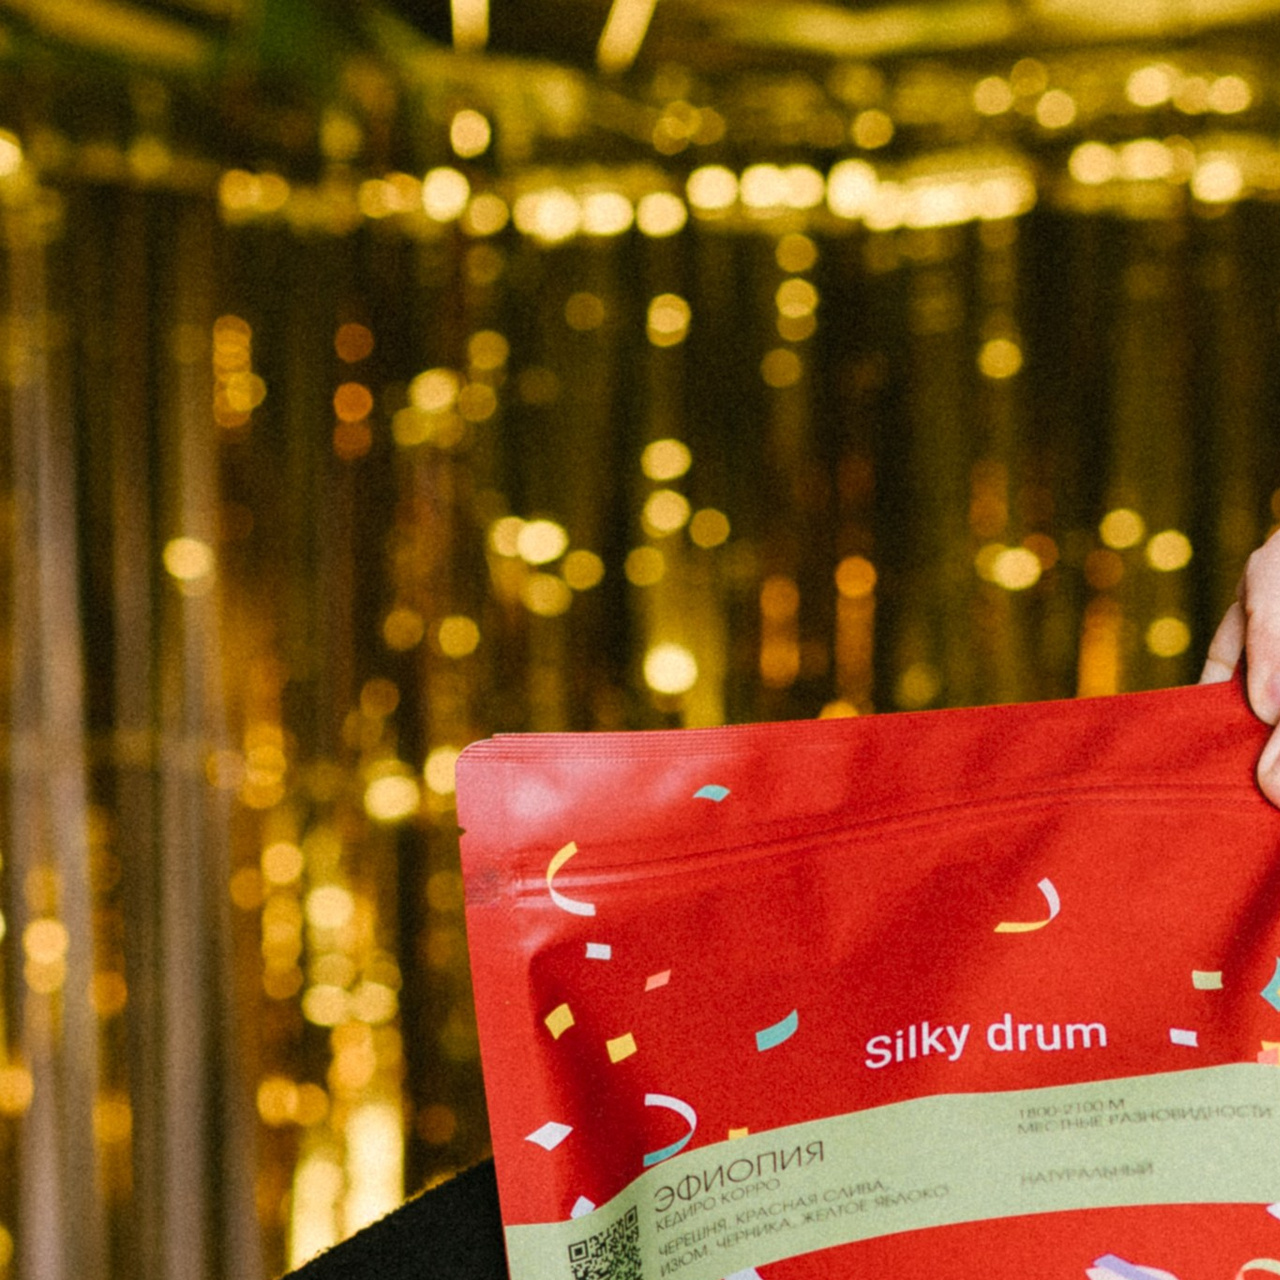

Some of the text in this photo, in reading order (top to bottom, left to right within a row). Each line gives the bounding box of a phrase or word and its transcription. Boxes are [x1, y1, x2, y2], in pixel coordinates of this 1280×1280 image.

[865, 1013, 1107, 1069] Silky drum
[1017, 1104, 1273, 1135] МЕСТНЫЕ РАЗНОВИДНОСТИ
[654, 1140, 824, 1213] ЭФИОПИЯ
[1020, 1161, 1154, 1186] НАТУРАЛЬНЫЙ
[655, 1178, 782, 1233] КЕДИРО КОРРО
[736, 1193, 818, 1227] КРАСНАЯ
